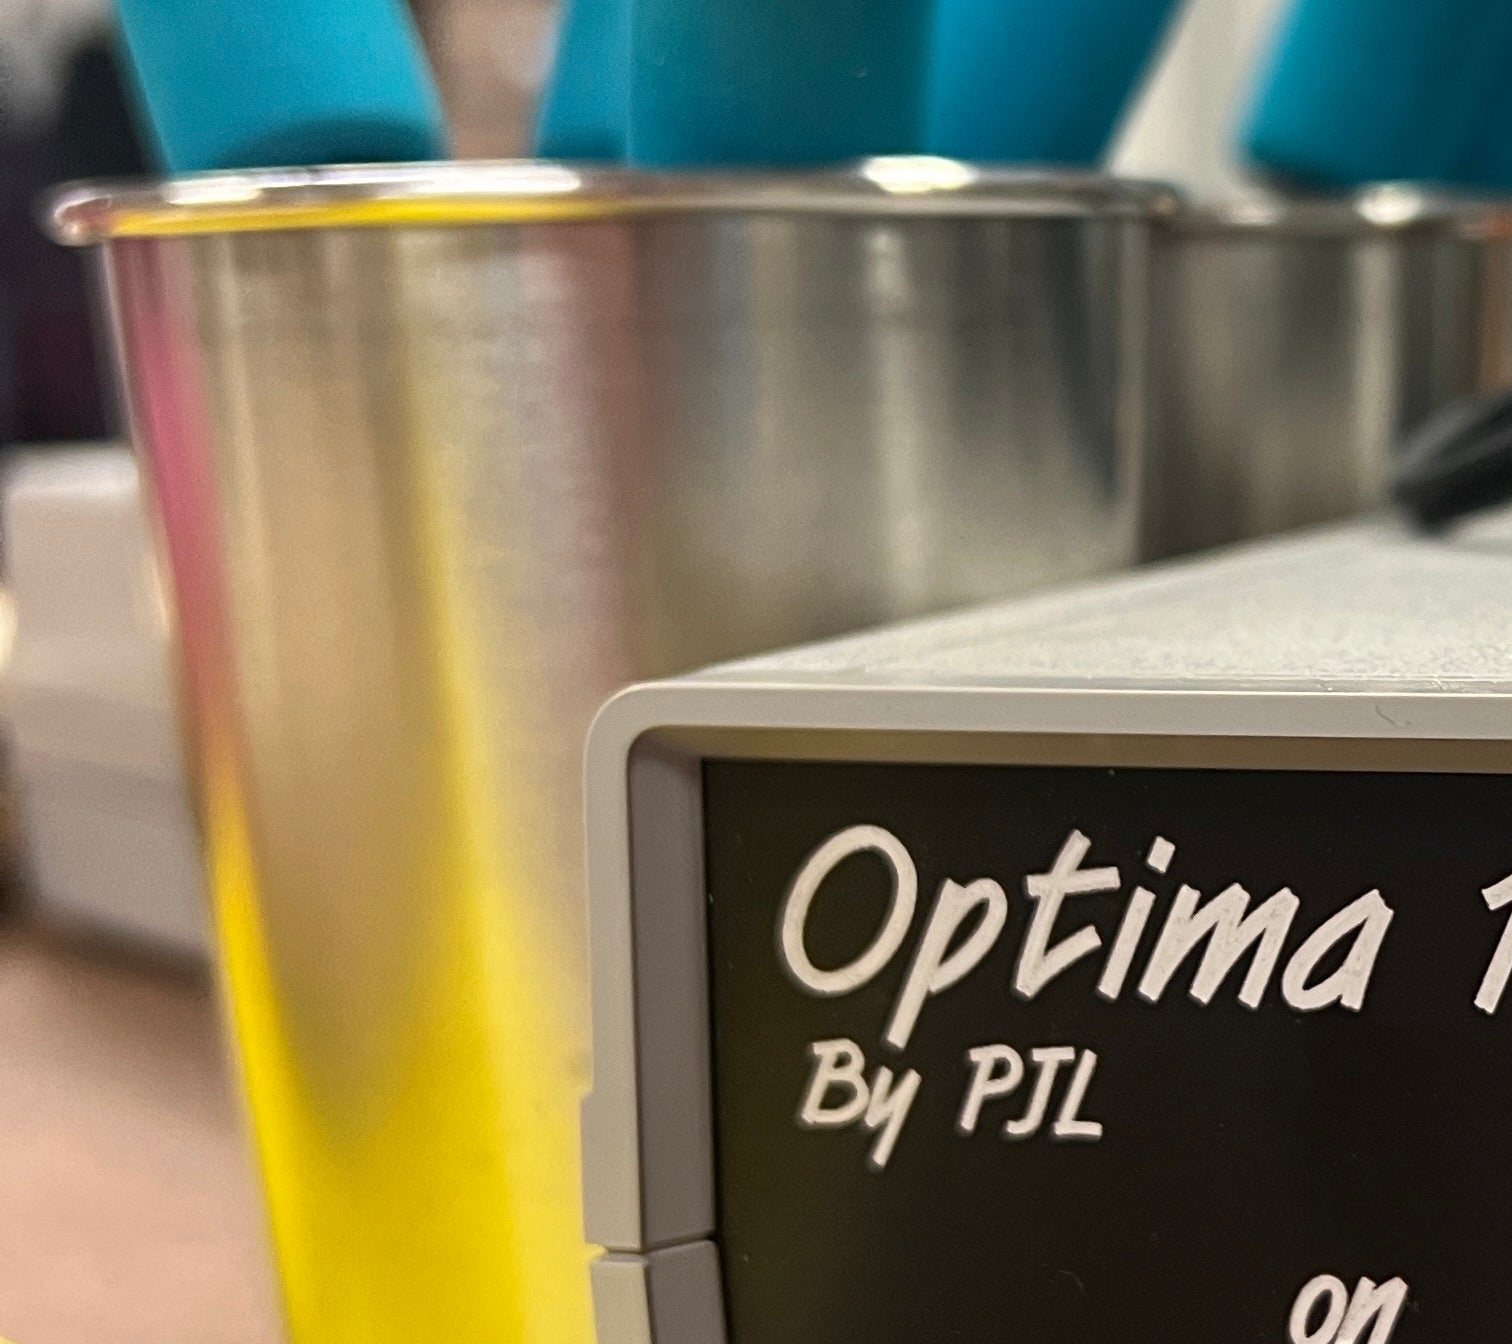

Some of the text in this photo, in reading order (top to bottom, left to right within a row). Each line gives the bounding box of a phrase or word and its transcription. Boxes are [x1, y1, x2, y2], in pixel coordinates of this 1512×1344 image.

[780, 823, 1395, 1050] Optima
[800, 1038, 1103, 1170] By PJL
